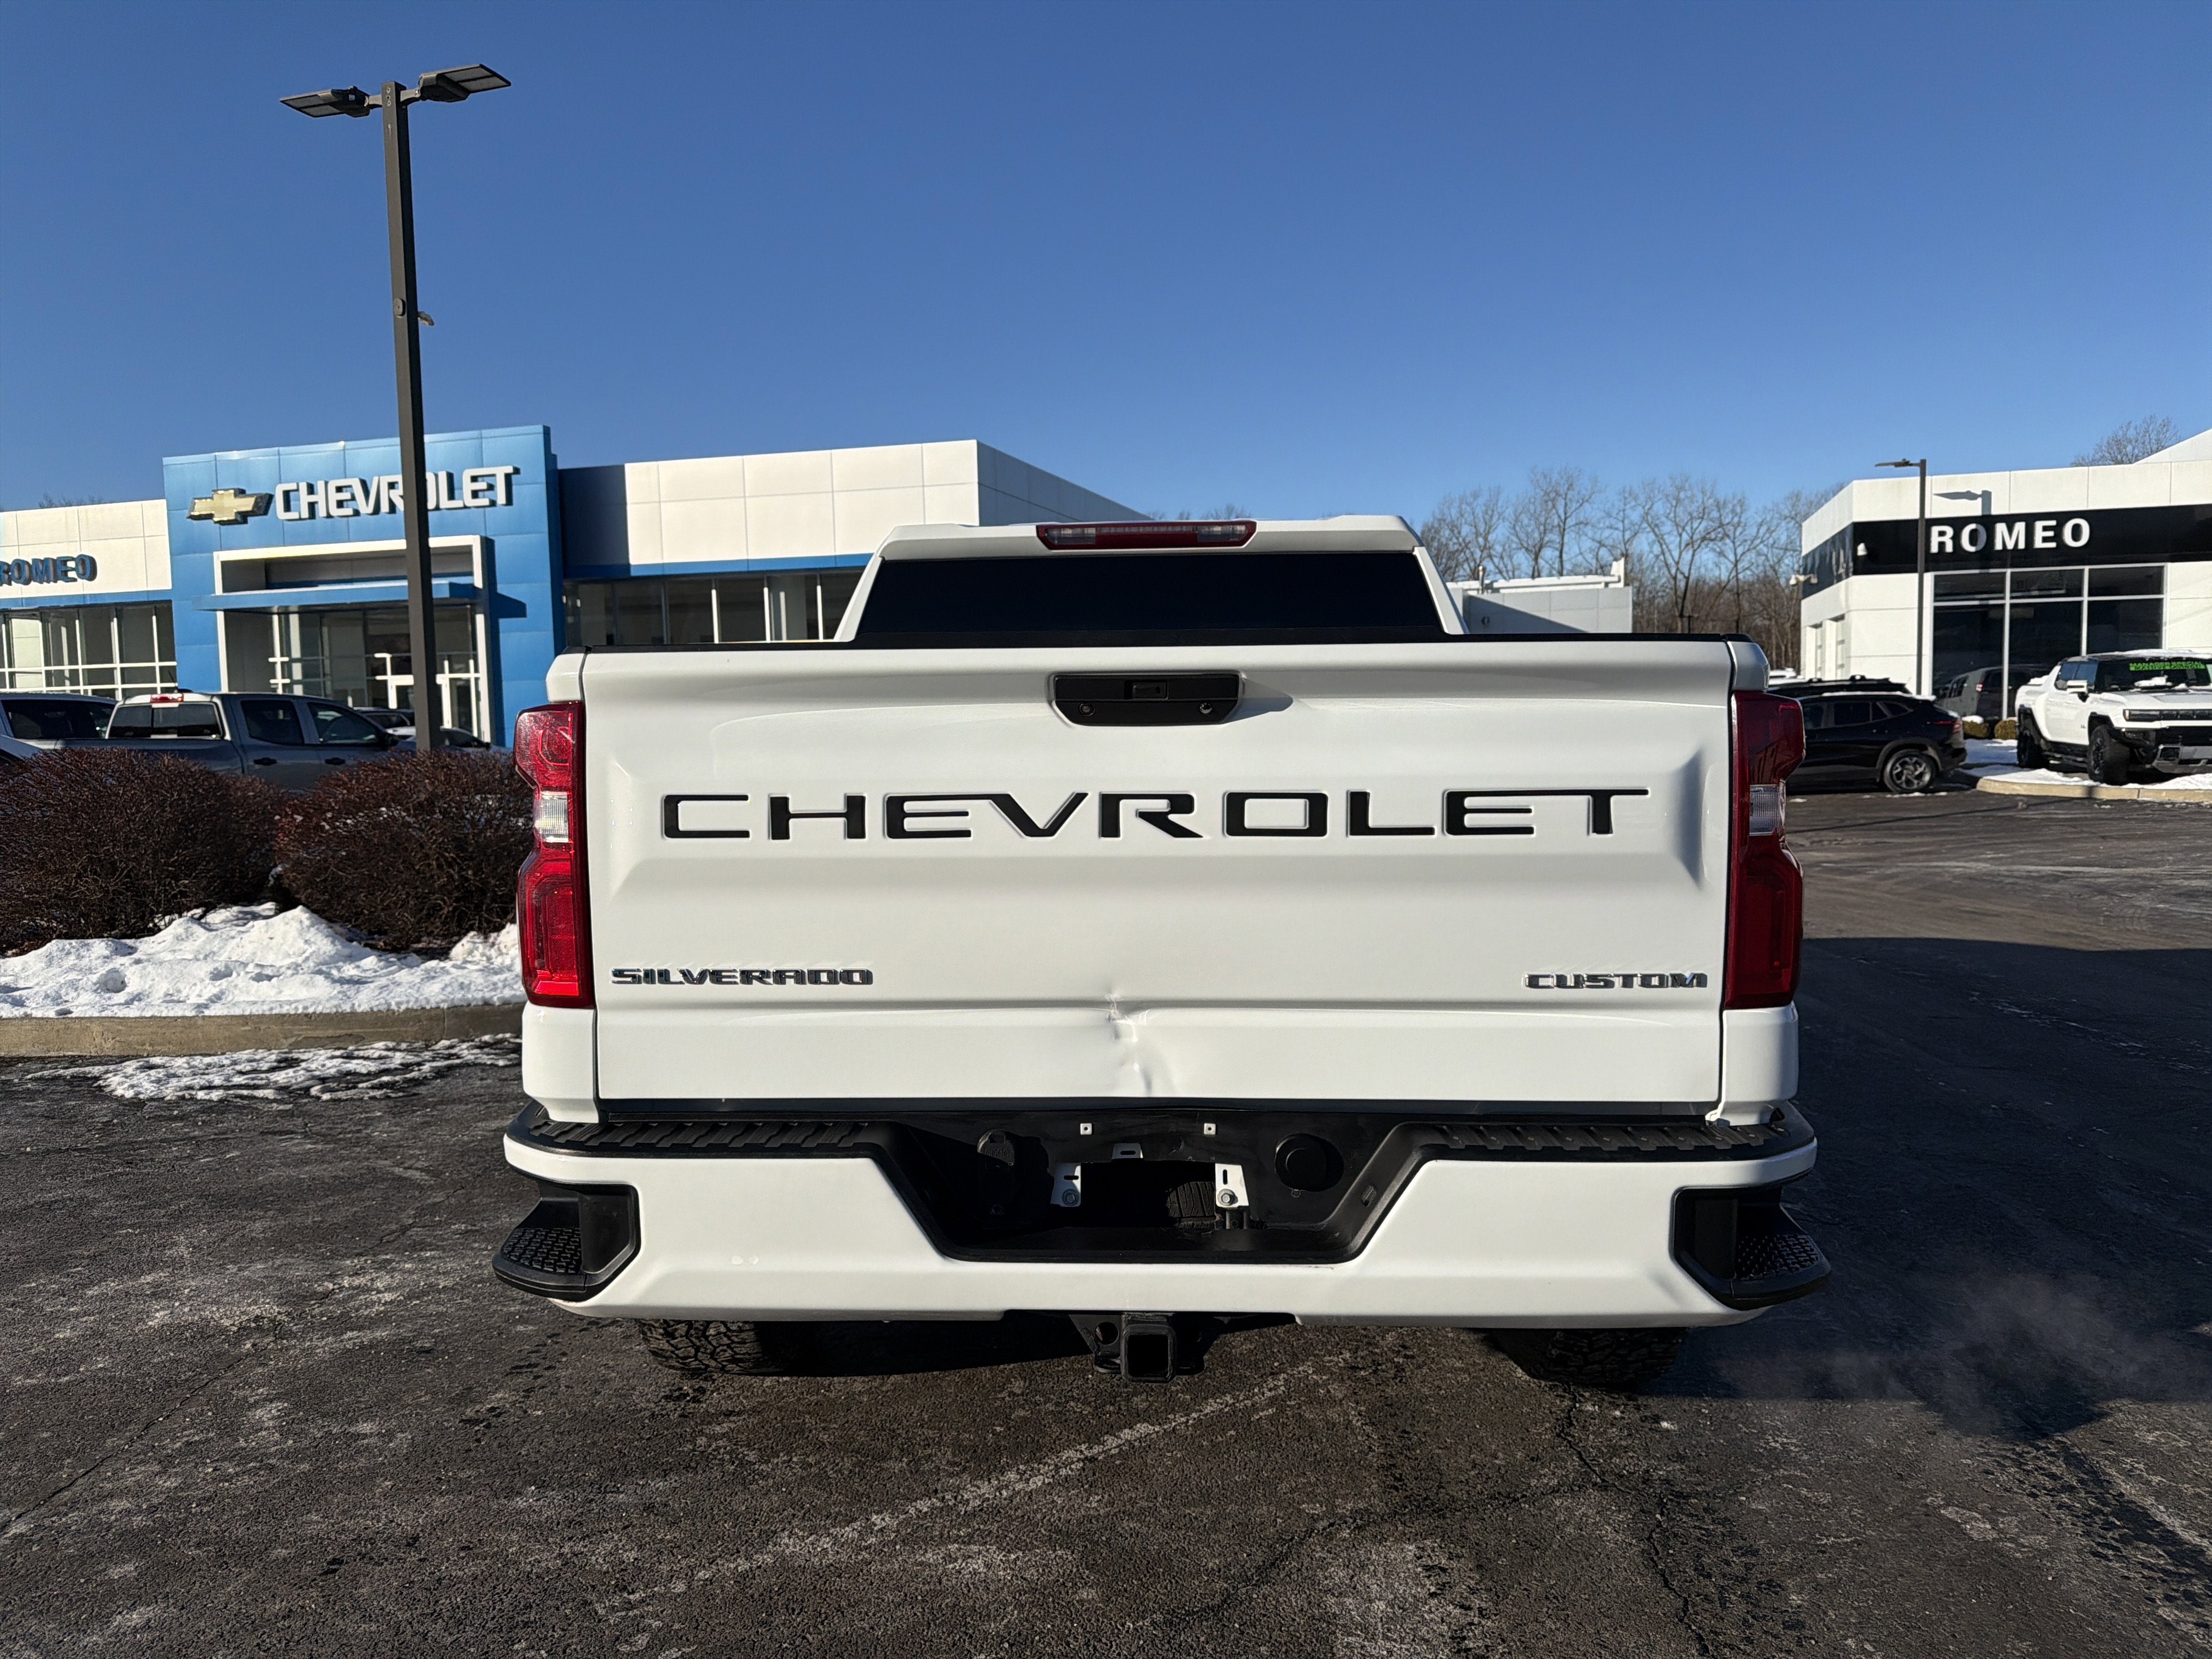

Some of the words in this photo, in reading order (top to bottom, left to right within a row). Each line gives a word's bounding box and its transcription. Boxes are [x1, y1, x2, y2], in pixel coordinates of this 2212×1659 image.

[1930, 518, 2090, 554] ROMEO
[664, 789, 1649, 838] CHEVROLET
[611, 968, 873, 985] SILVERADO
[1524, 973, 1708, 988] CUSTOM
